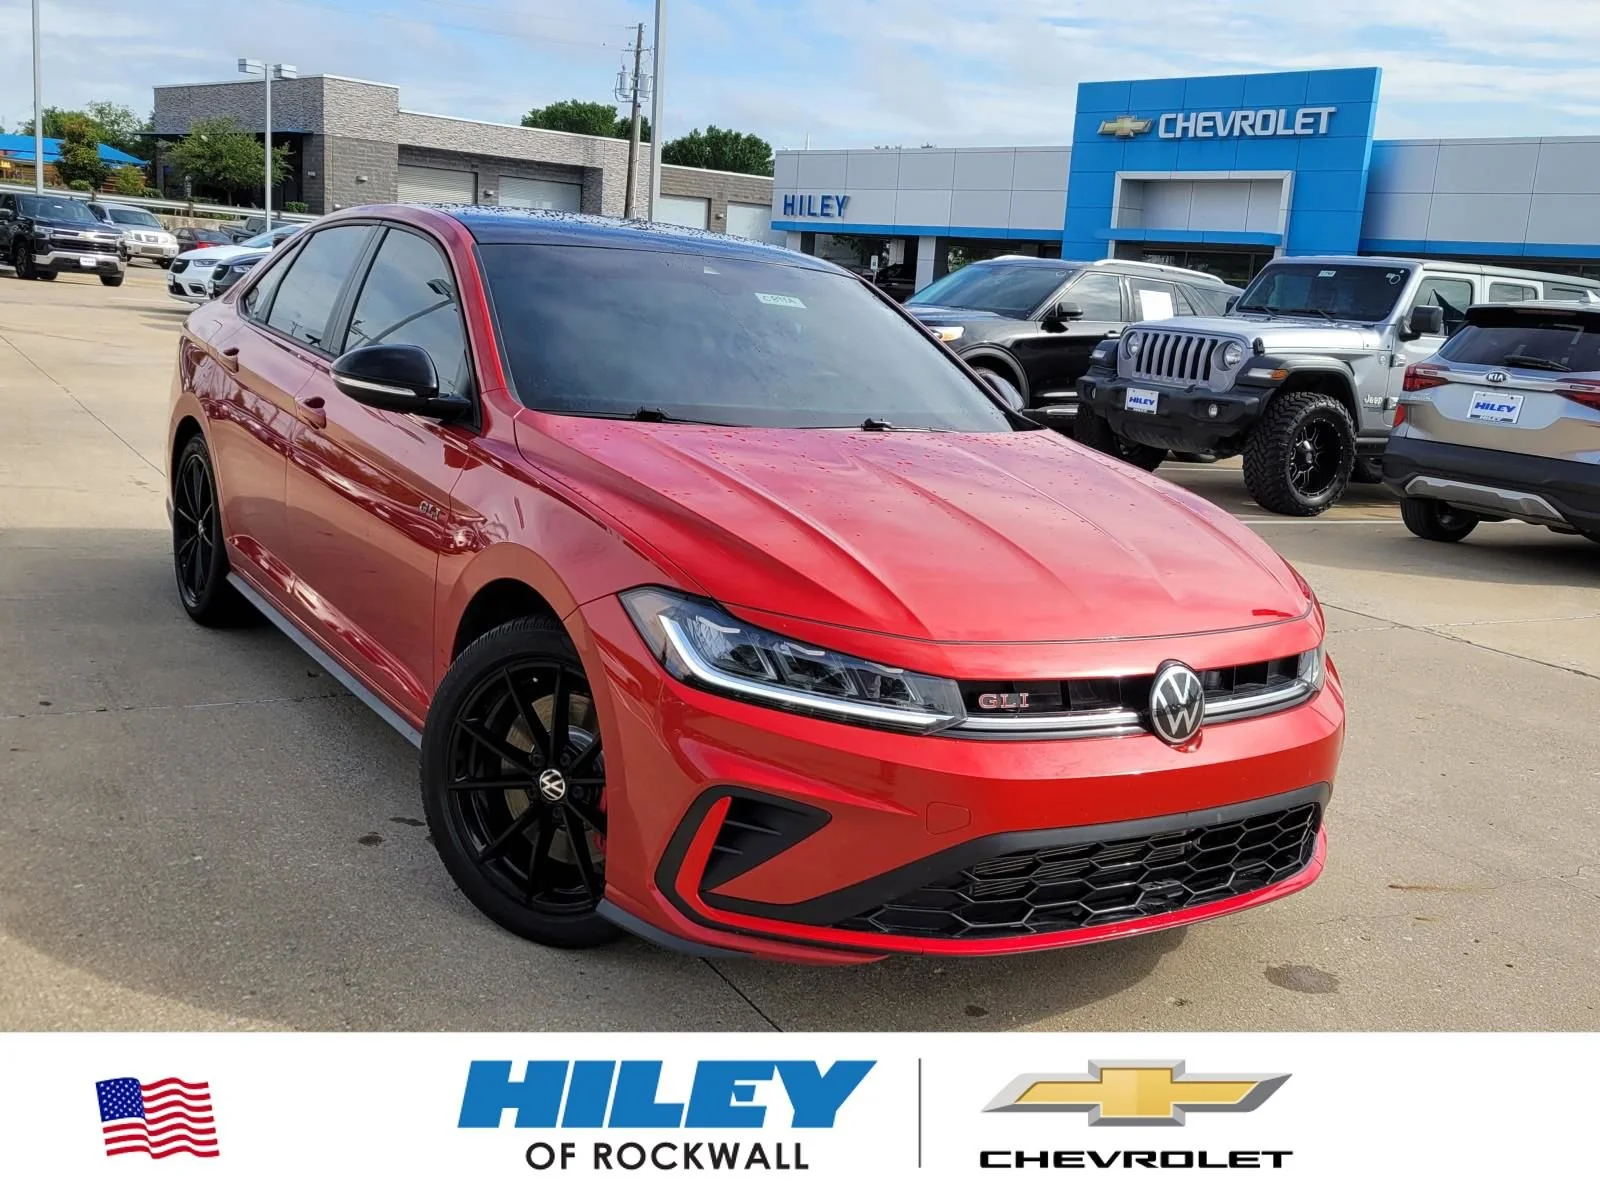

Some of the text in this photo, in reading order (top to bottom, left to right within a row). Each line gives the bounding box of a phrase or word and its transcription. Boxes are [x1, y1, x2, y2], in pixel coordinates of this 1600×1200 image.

[1158, 106, 1337, 138] CHEVROLET
[783, 194, 849, 217] HILEY
[1129, 396, 1155, 406] HILEY
[1364, 394, 1383, 405] Jeep
[1474, 401, 1516, 413] HILEY
[419, 500, 441, 521] GLI
[978, 692, 1030, 709] GLI
